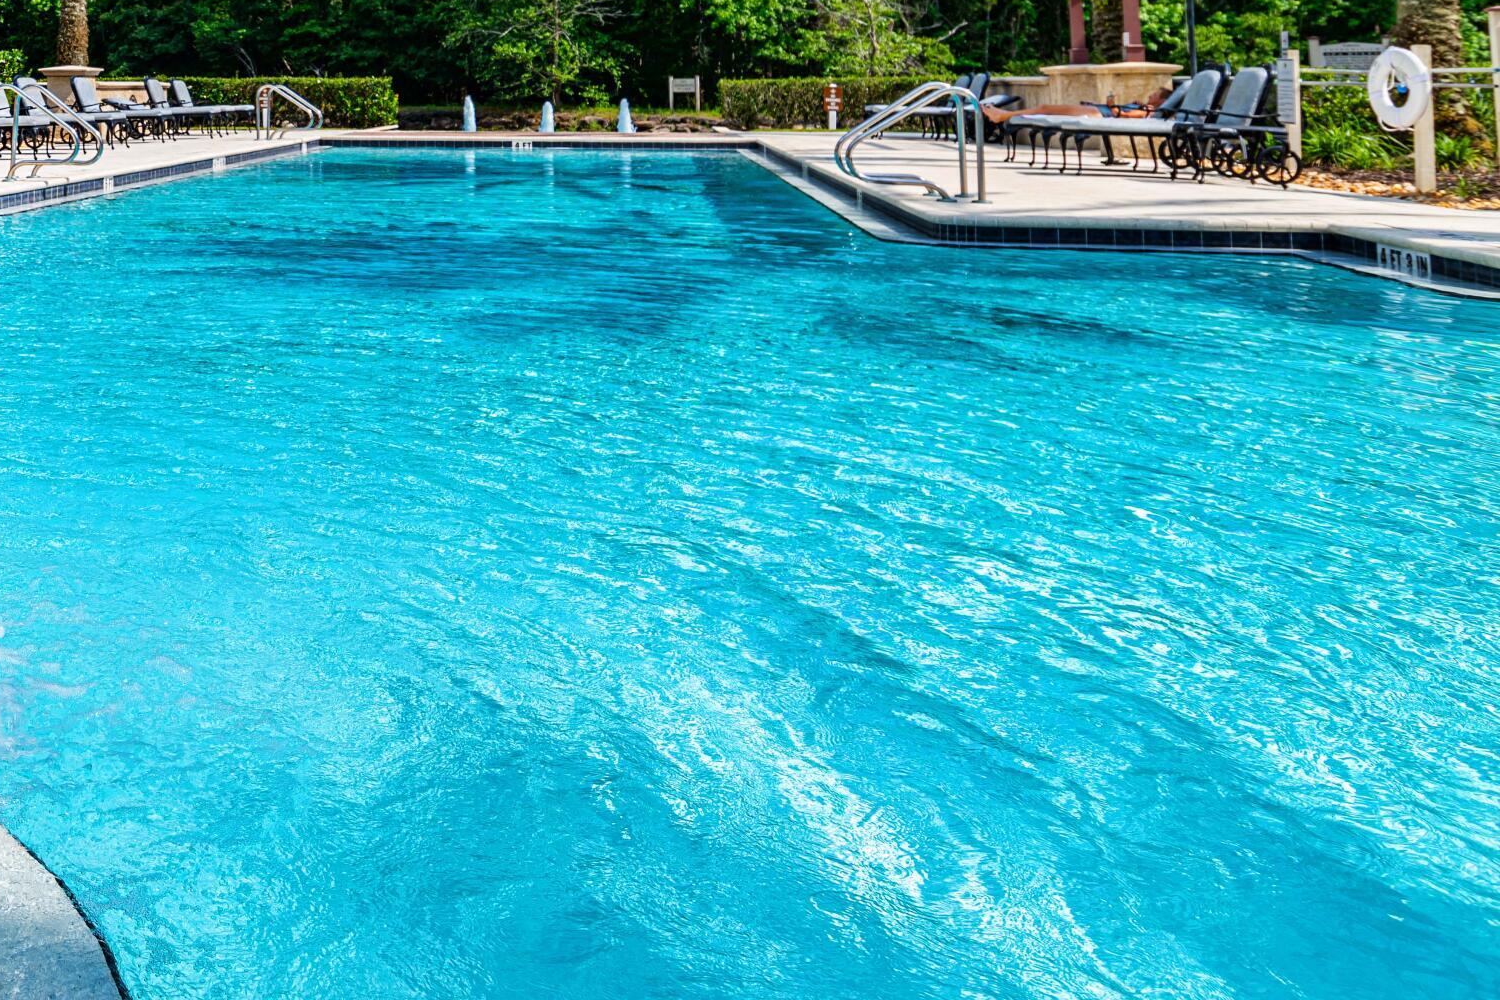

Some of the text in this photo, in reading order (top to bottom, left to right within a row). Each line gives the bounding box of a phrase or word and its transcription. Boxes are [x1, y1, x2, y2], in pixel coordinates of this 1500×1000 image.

[1381, 247, 1387, 264] 4
[1390, 249, 1402, 267] FT
[1416, 255, 1428, 271] IN
